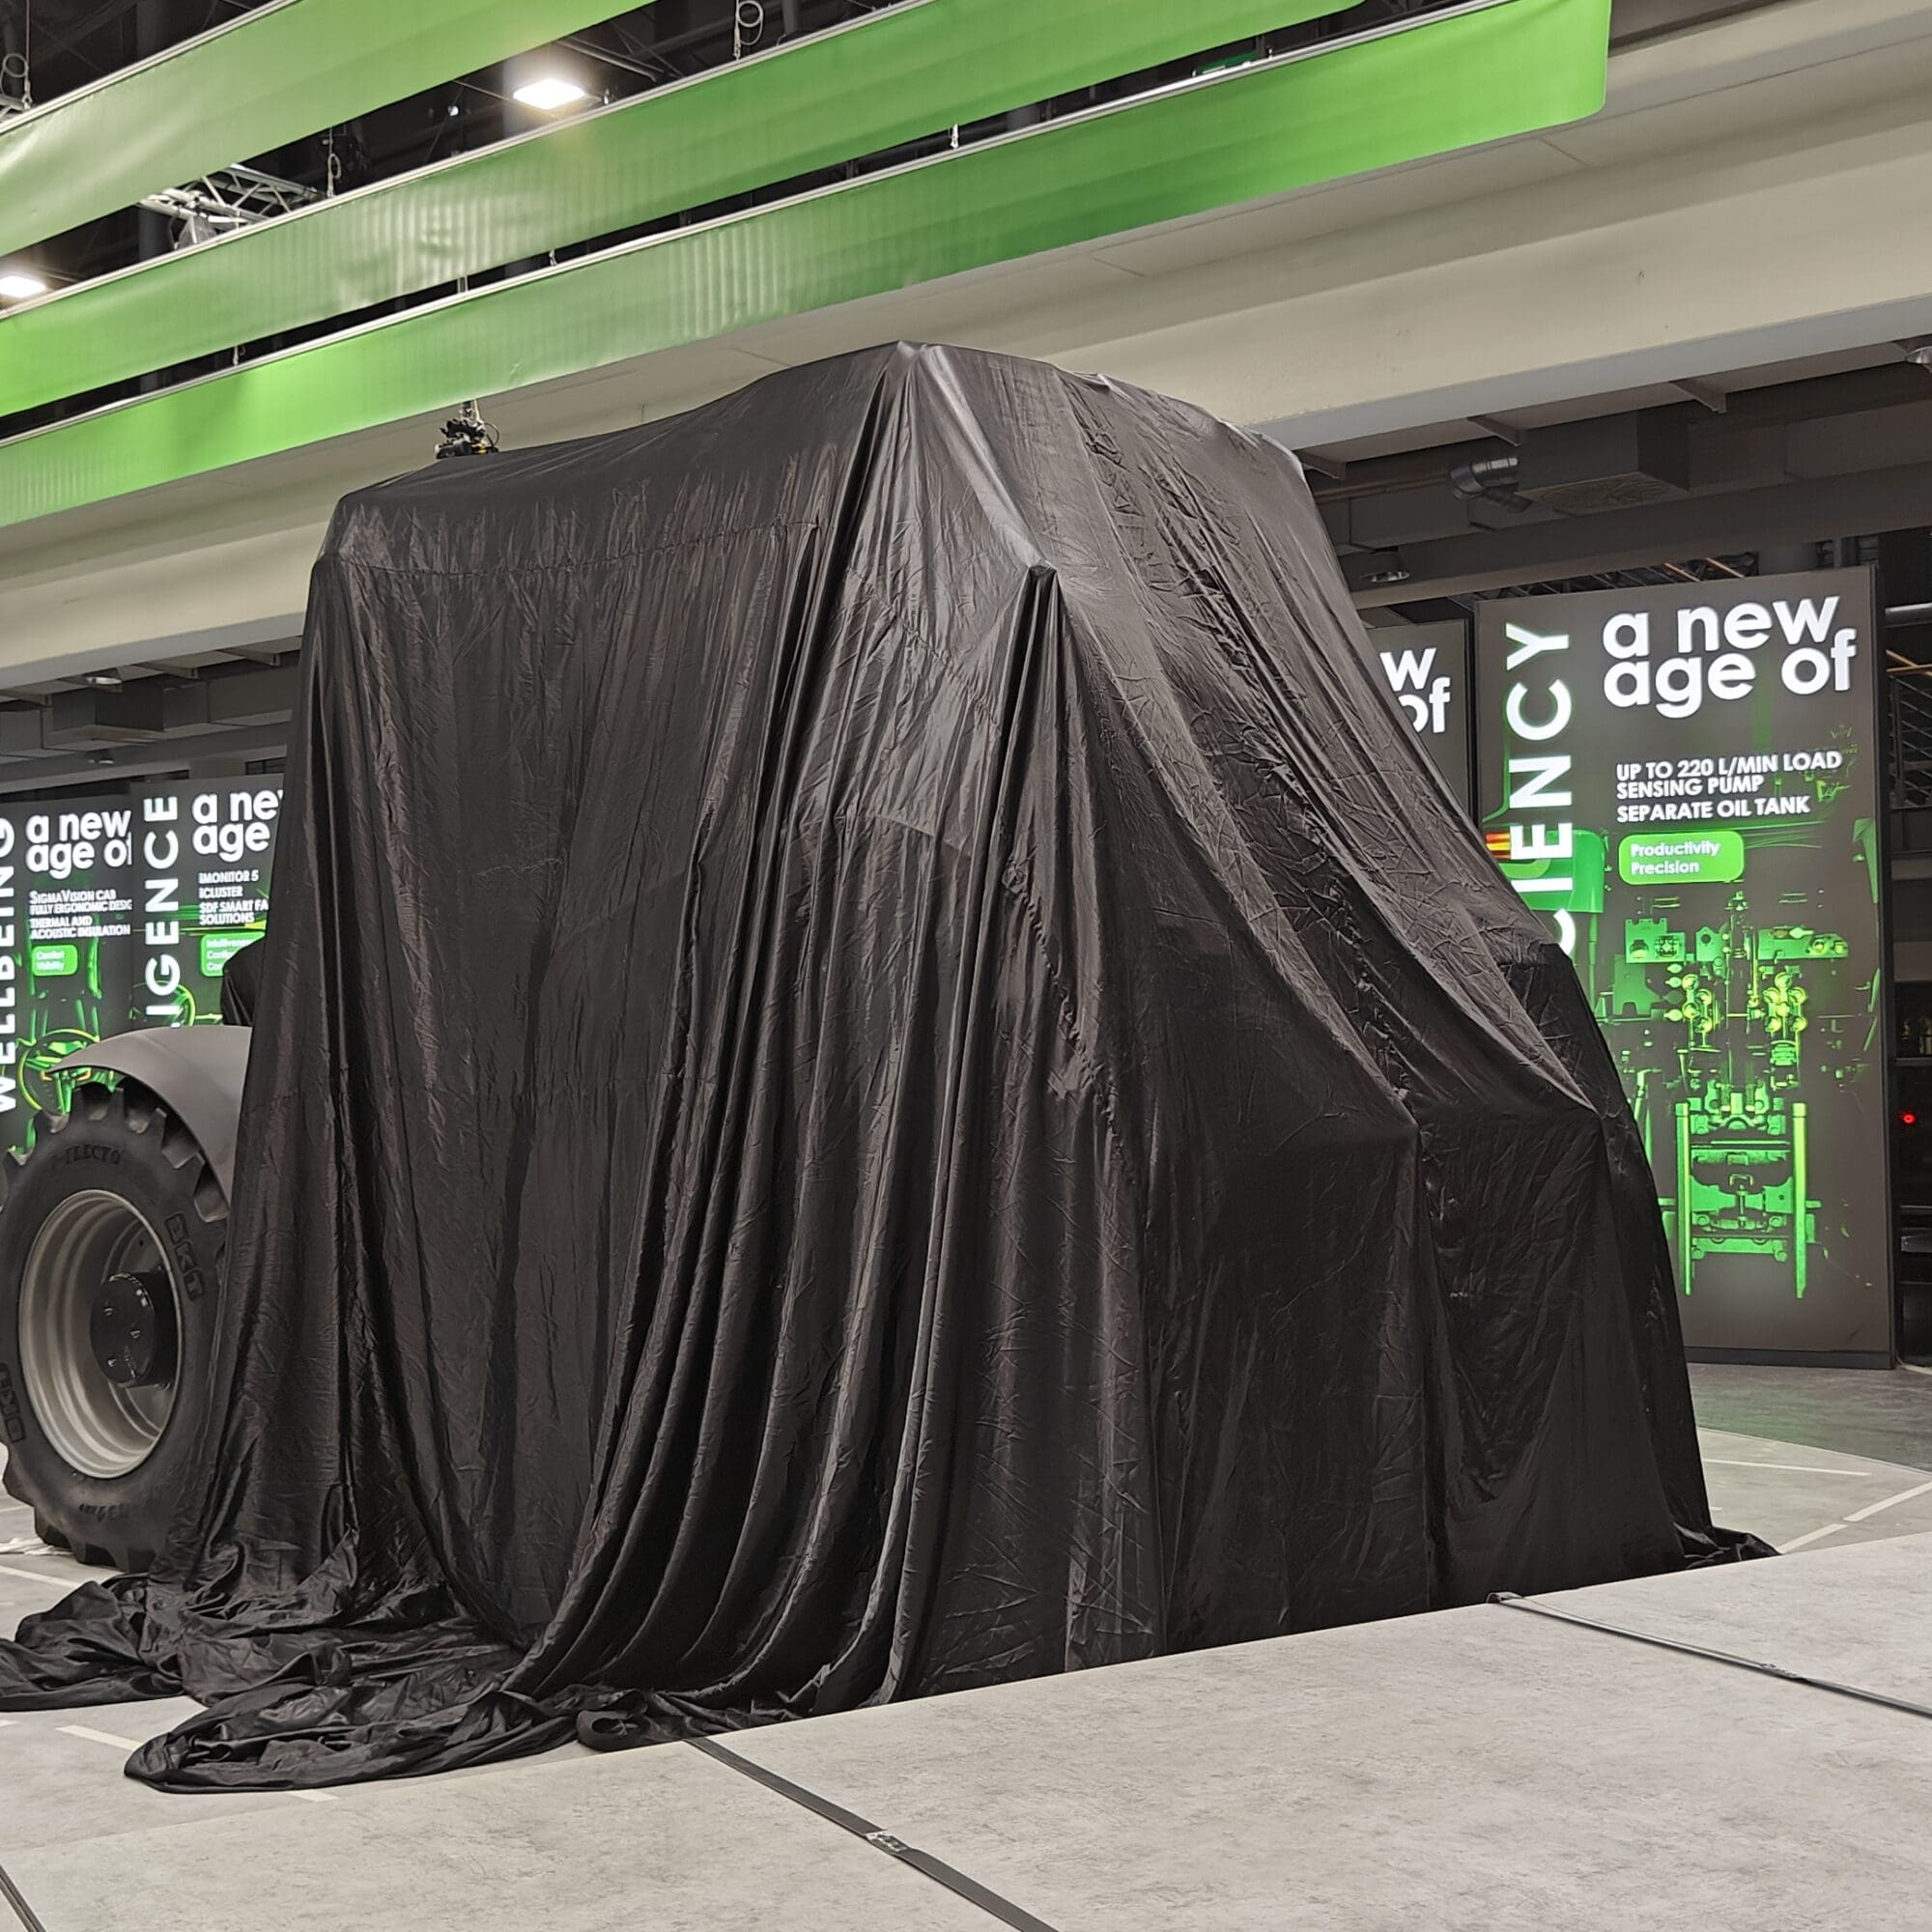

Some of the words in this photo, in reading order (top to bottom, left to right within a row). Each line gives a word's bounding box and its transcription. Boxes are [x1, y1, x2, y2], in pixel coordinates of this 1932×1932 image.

[1603, 611, 1649, 659] a
[1677, 596, 1840, 653] new
[1604, 652, 1756, 719] age
[1781, 628, 1857, 696] of
[1398, 677, 1450, 733] of
[1616, 763, 1641, 781] UP
[1645, 761, 1673, 779] TO
[1677, 758, 1714, 778] 220
[1719, 754, 1778, 778] L/MIN
[1783, 751, 1843, 772] LOAD
[1616, 779, 1703, 800] SENSING
[1707, 775, 1765, 795] PUMP
[192, 793, 217, 824] a
[230, 789, 283, 821] ne
[1616, 800, 1713, 823] SEPARATE
[1717, 798, 1752, 818] OIL
[1754, 795, 1811, 816] TANK
[26, 814, 48, 844] a
[59, 810, 131, 841] new
[193, 821, 270, 863] age
[1630, 840, 1721, 858] Productivity
[26, 839, 95, 879] age
[1630, 860, 1700, 875] Precision
[251, 869, 259, 881] 5
[29, 903, 53, 916] FULLY
[54, 901, 108, 914] ERGONOMIC
[144, 796, 181, 1029] IGENCE
[199, 912, 255, 925] SOLUTIONS
[219, 899, 254, 912] SMART
[30, 917, 71, 928] THERMAL
[71, 915, 93, 926] AND
[30, 927, 76, 940] ACOUSTIC
[77, 924, 130, 938] INSULATION
